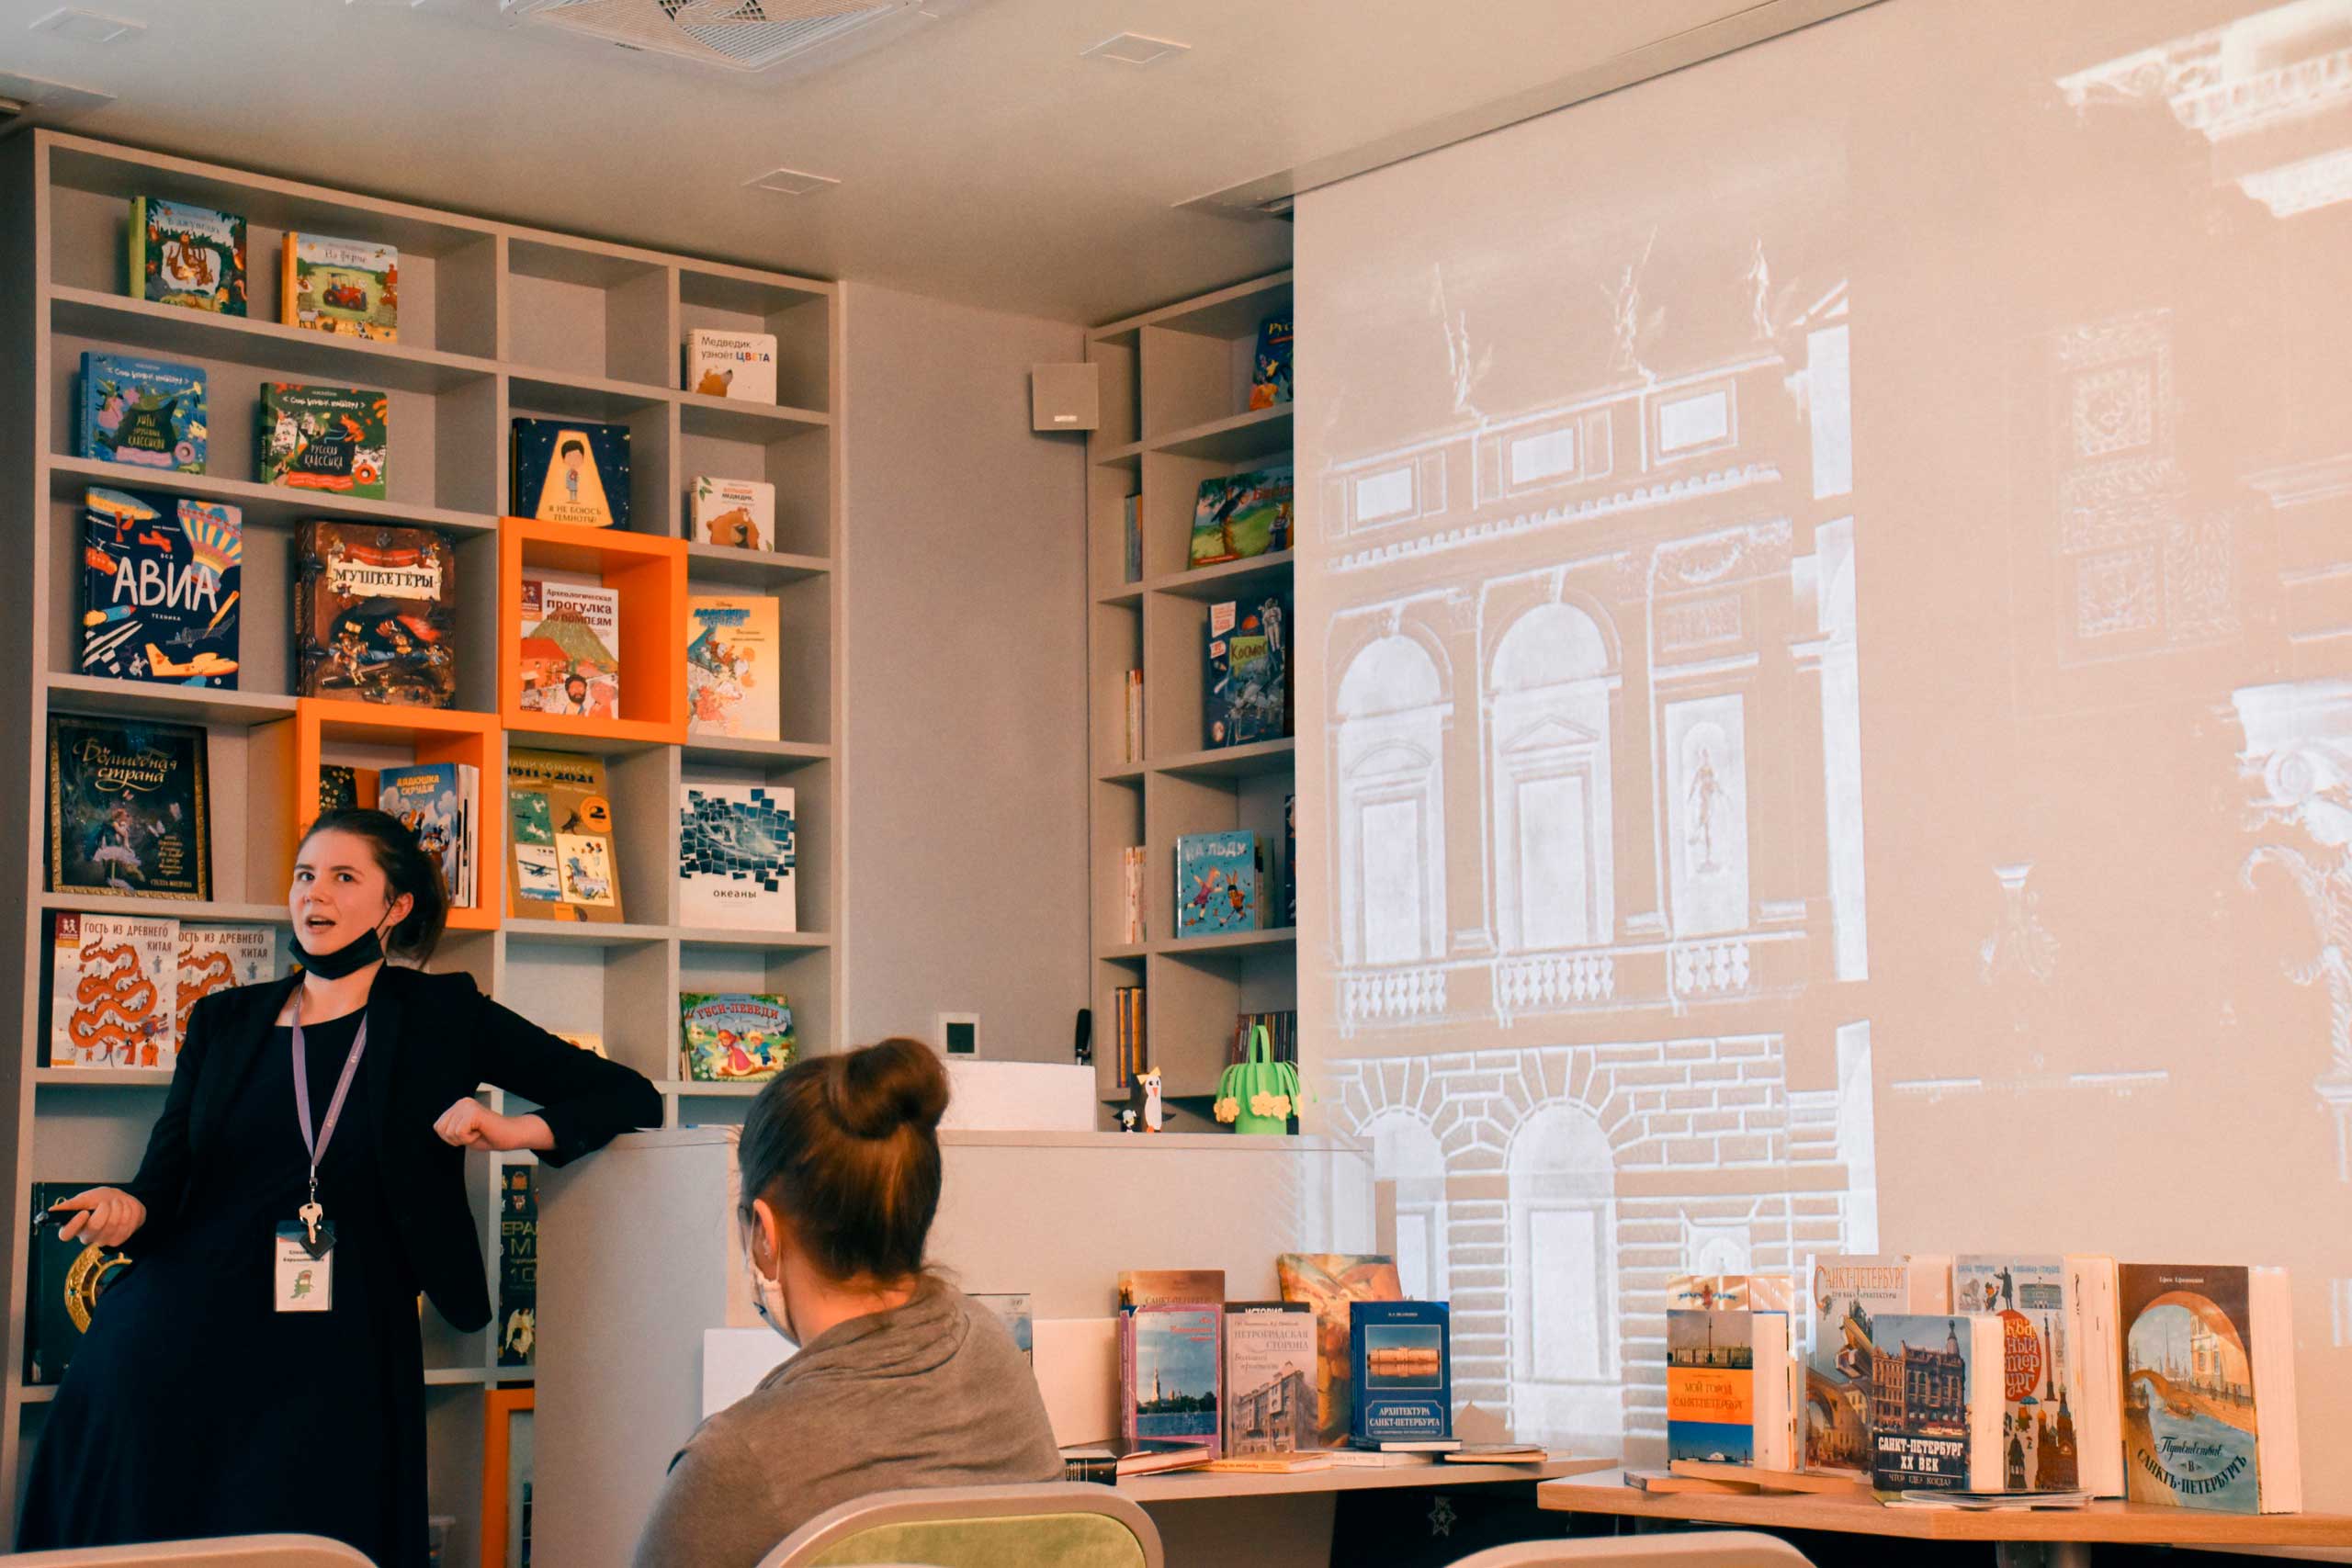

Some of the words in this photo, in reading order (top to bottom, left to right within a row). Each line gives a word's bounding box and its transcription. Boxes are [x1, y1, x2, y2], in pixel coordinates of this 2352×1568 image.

[701, 336, 752, 349] Медведик
[736, 352, 770, 363] ЦВЕТА
[311, 444, 338, 455] РУССКАЯ
[304, 455, 344, 469] КЛАССИКА
[334, 568, 435, 589] МУШКЕТЁРЫ
[112, 557, 218, 614] АВИА
[547, 599, 613, 615] прогулка
[96, 767, 165, 788] страна
[713, 889, 757, 898] океаны
[85, 921, 108, 934] ГОСТЬ
[113, 924, 123, 934] ИЗ
[127, 925, 168, 938] ДРЕВНЕГО
[178, 932, 199, 943] ОСТЬ
[204, 933, 215, 943] ИЗ
[220, 933, 264, 944] ДРЕВНЕГО
[147, 942, 172, 952] КИТАЯ
[241, 949, 267, 958] КИТАЯ
[1379, 1406, 1430, 1416] АРХИТЕКТУРА
[1369, 1418, 1441, 1427] САНКТ-ПЕТЕРБУРГА
[1878, 1436, 1963, 1457] САНКТ-ПЕТЕРБУРГ
[2154, 1436, 2223, 1461] Путешествие
[1901, 1455, 1914, 1470] XX
[1918, 1457, 1939, 1472] ВЕК
